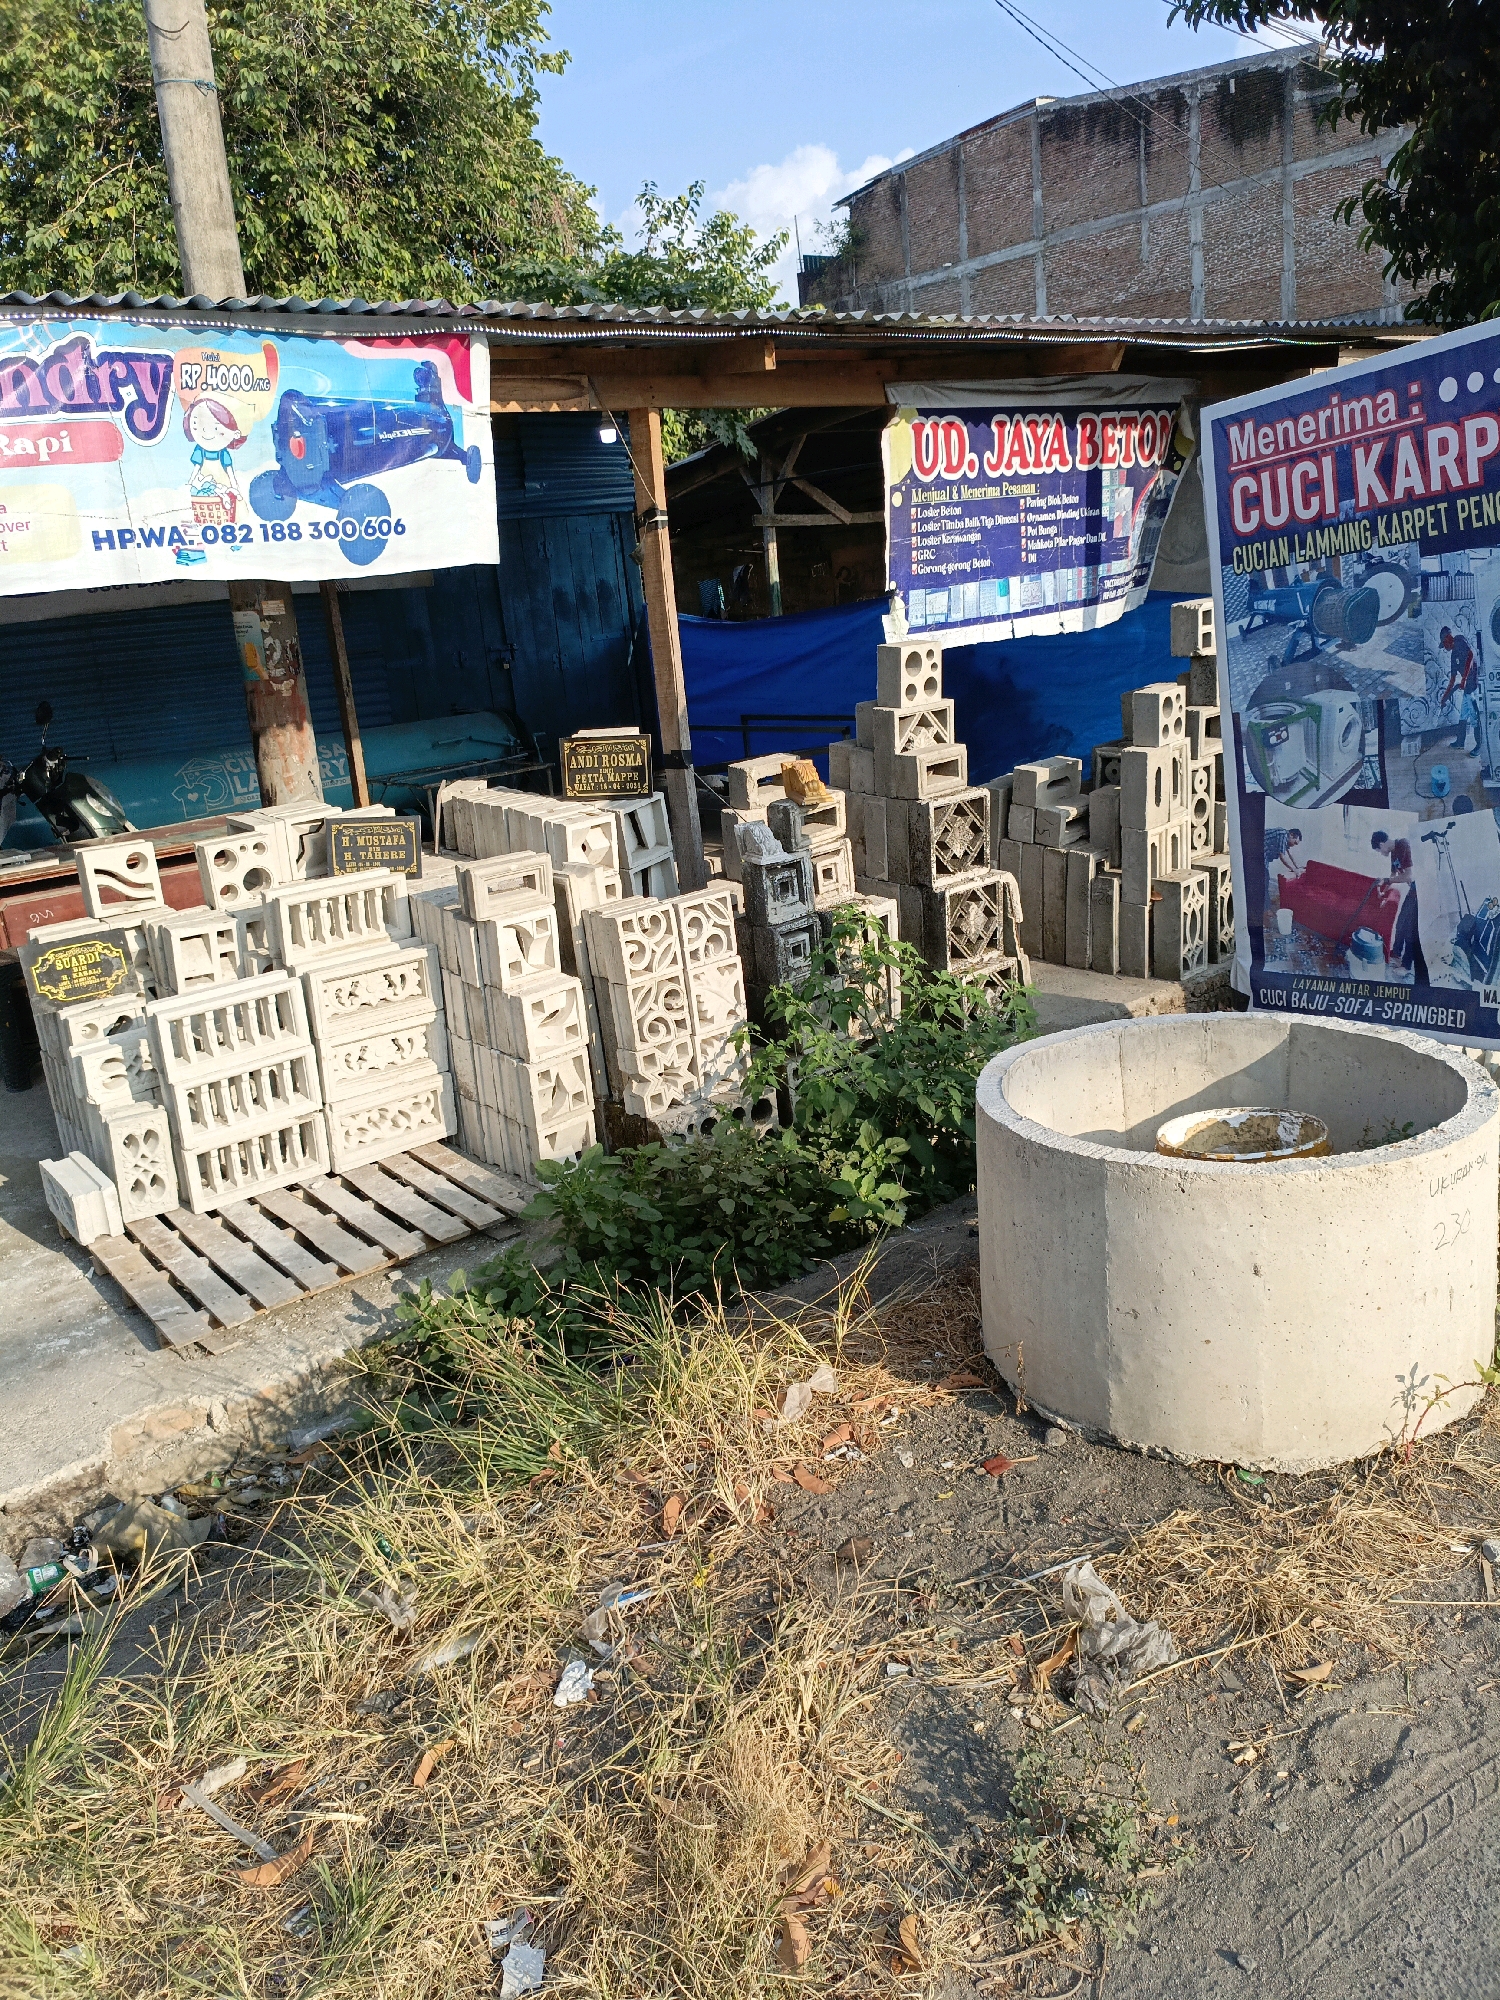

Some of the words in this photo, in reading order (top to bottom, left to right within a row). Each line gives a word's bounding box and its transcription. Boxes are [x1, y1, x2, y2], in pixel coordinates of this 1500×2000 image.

[1228, 391, 1397, 463] Menerima
[910, 418, 977, 478] UD.
[984, 416, 1072, 472] JAYA
[1077, 414, 1175, 467] BETON
[911, 486, 950, 504] Menjual
[952, 485, 959, 499] &
[960, 483, 1001, 499] Menerima
[1231, 456, 1337, 534] CUCI
[941, 505, 962, 516] Beton
[201, 524, 254, 545] 082
[260, 522, 302, 542] 188
[308, 520, 359, 541] 300
[363, 518, 407, 538] 606
[917, 534, 941, 547] Loster
[1027, 526, 1038, 536] Pot
[1038, 525, 1058, 537] Bunga
[1232, 539, 1290, 575] CUCIAN
[1294, 519, 1372, 562] LAMMING
[1377, 502, 1448, 548] KARPET
[918, 548, 936, 560] GRC
[972, 558, 991, 569] Beton
[569, 754, 599, 769] ANDI
[601, 752, 642, 767] ROSMA
[575, 773, 605, 783] PETTA
[607, 772, 639, 782] MAPPE
[356, 834, 407, 847] MUSTAFA
[55, 951, 102, 971] SUARDI
[1259, 988, 1287, 1007] CUCI
[1292, 977, 1336, 993] LAYANAN
[1338, 981, 1370, 997] ANTAR
[1373, 985, 1412, 1001] JEMPUT
